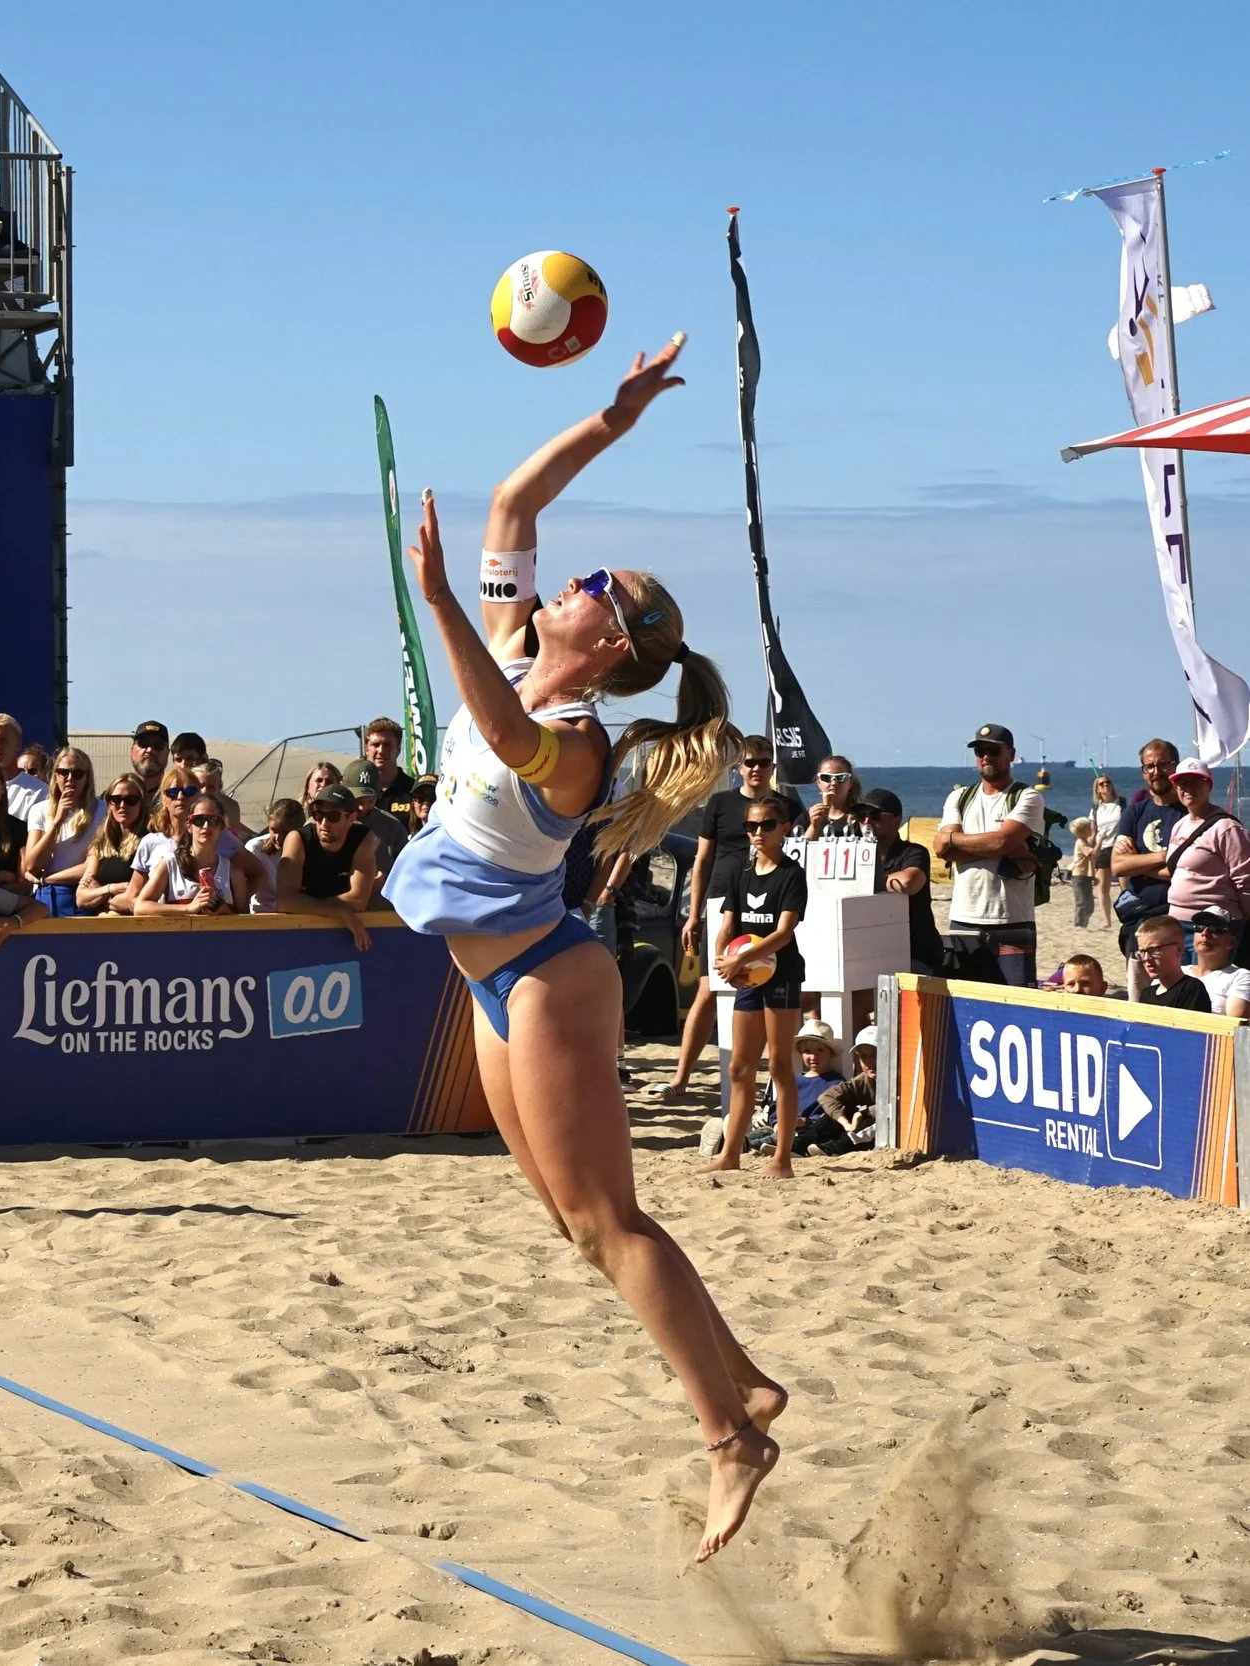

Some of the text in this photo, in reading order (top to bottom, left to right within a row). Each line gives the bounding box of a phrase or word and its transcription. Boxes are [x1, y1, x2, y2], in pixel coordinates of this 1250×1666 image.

[13, 954, 256, 1045] Liefmans
[283, 971, 351, 1024] 0.0
[61, 1029, 214, 1054] ON THE ROCKS
[969, 1020, 1102, 1117] SOLID
[1045, 1118, 1104, 1158] RENTAL
